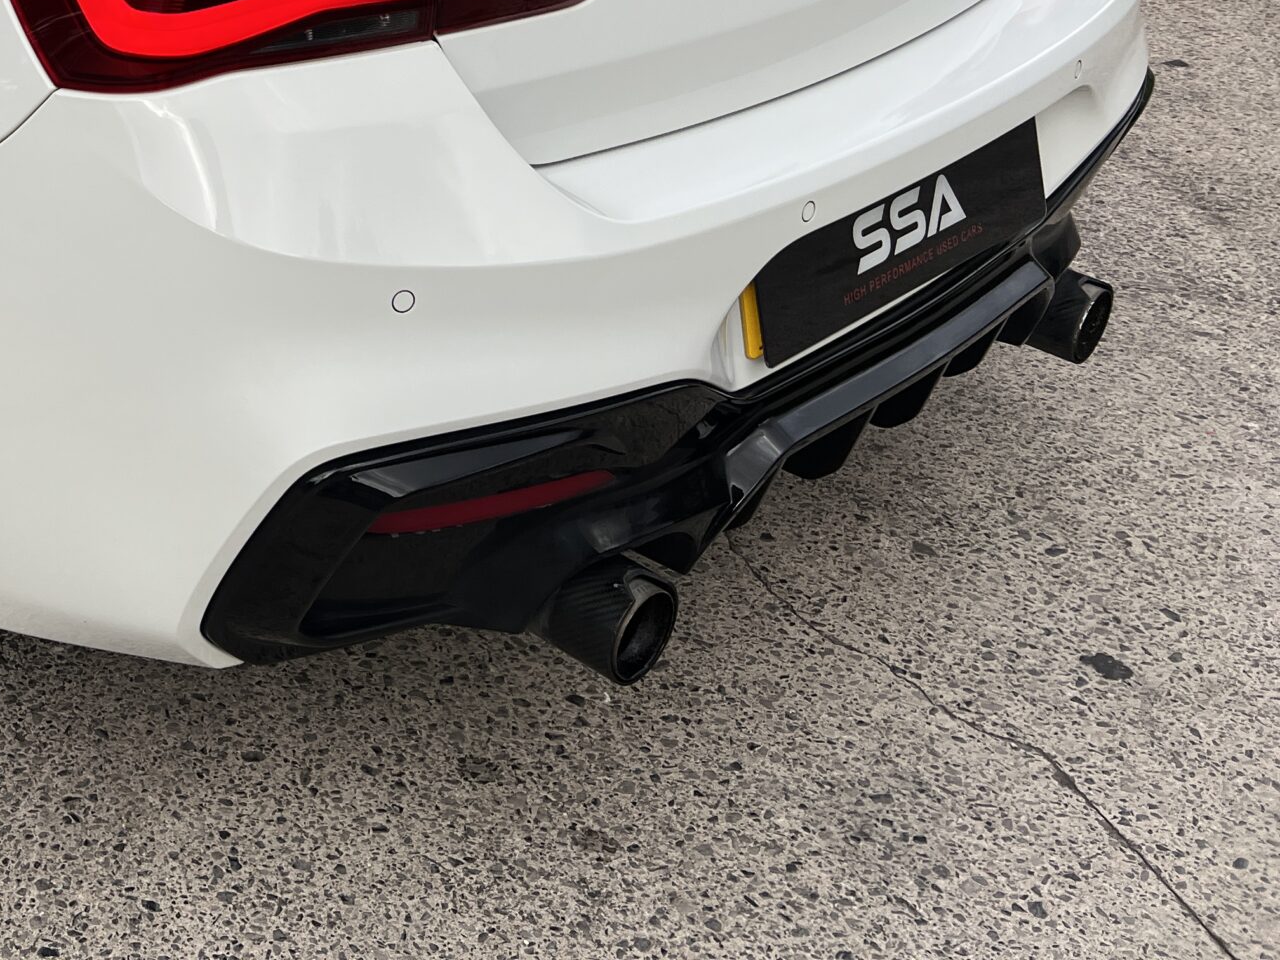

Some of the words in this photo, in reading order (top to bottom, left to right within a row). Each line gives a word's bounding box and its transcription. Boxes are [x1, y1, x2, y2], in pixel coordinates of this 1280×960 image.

[843, 285, 867, 306] HIGH
[869, 247, 934, 293] PERFORMANCE
[936, 234, 959, 256] USED
[961, 222, 983, 243] CARS
[852, 173, 967, 275] SSA
